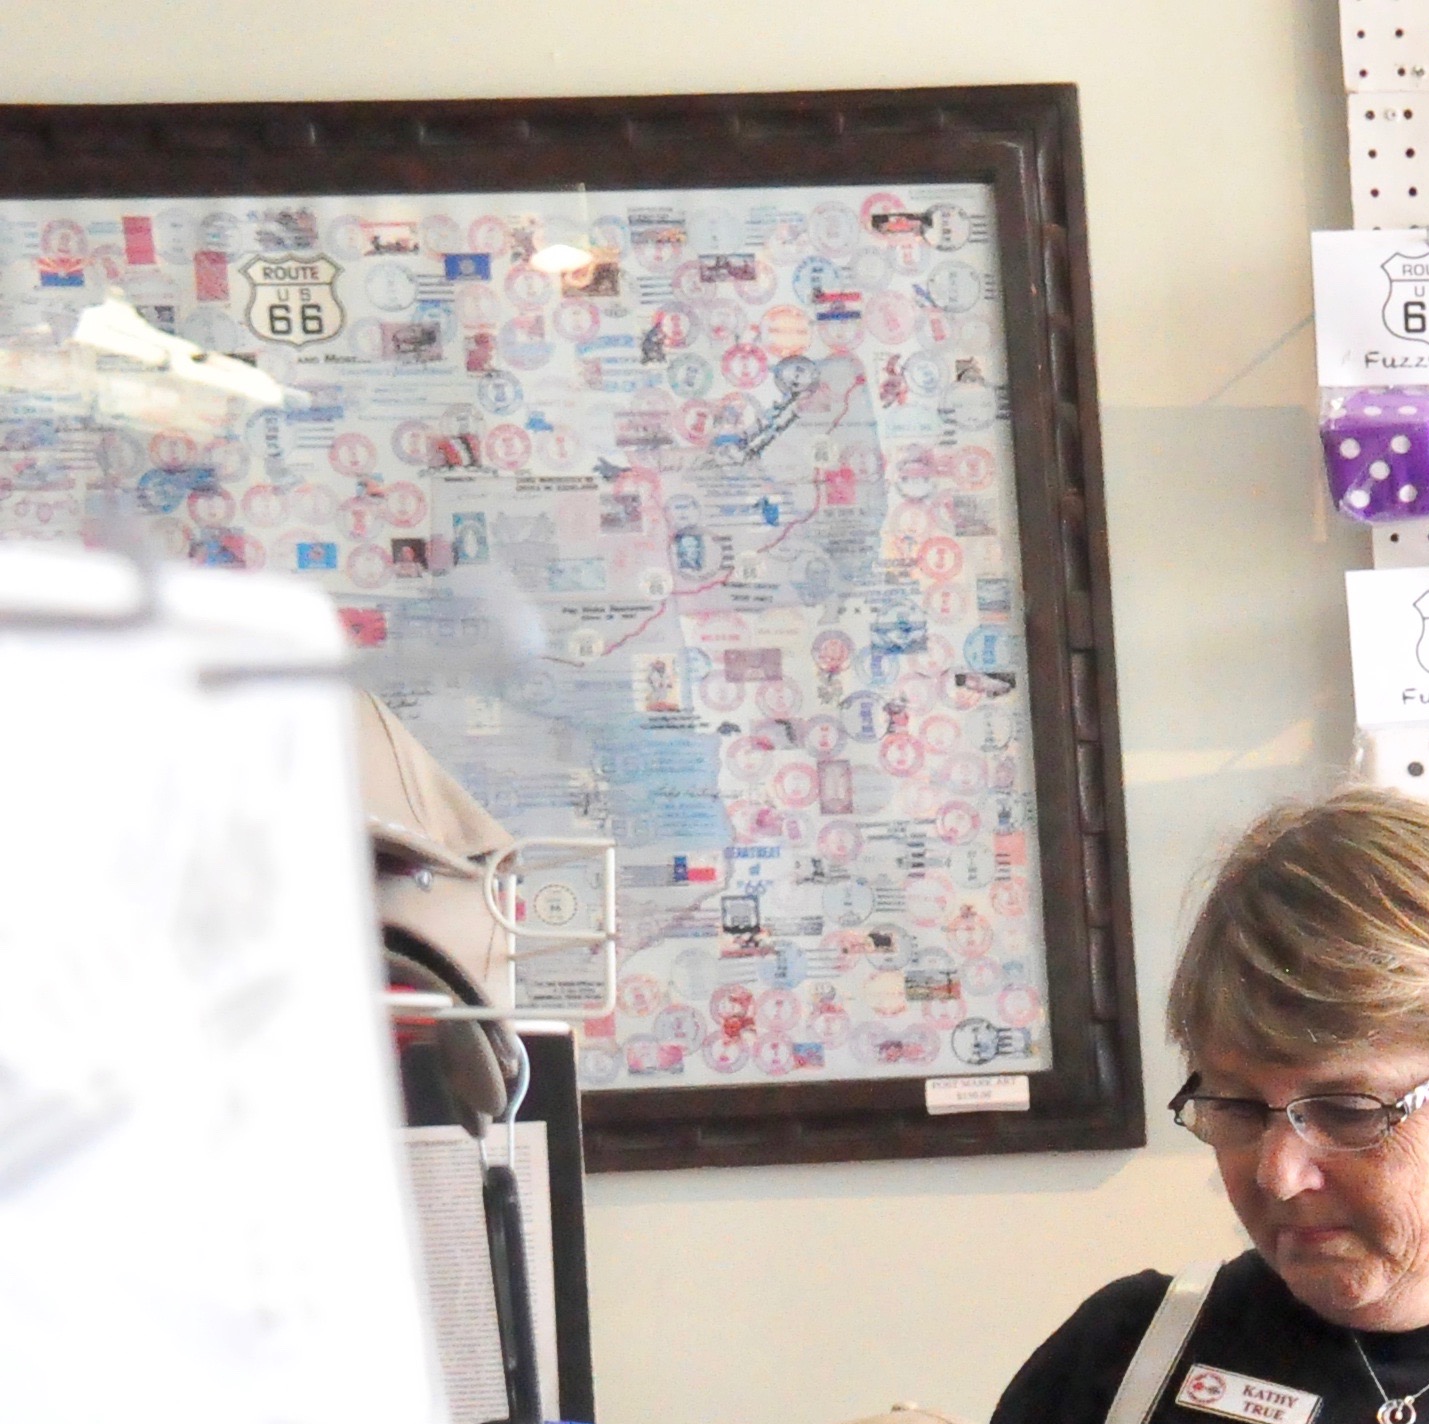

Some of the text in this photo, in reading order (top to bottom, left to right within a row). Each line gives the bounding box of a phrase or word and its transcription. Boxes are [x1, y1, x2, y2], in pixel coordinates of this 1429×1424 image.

[263, 266, 320, 279] ROUTE
[269, 304, 323, 334] 66
[1243, 1384, 1300, 1409] KATHY
[1243, 1401, 1285, 1420] TRUE
